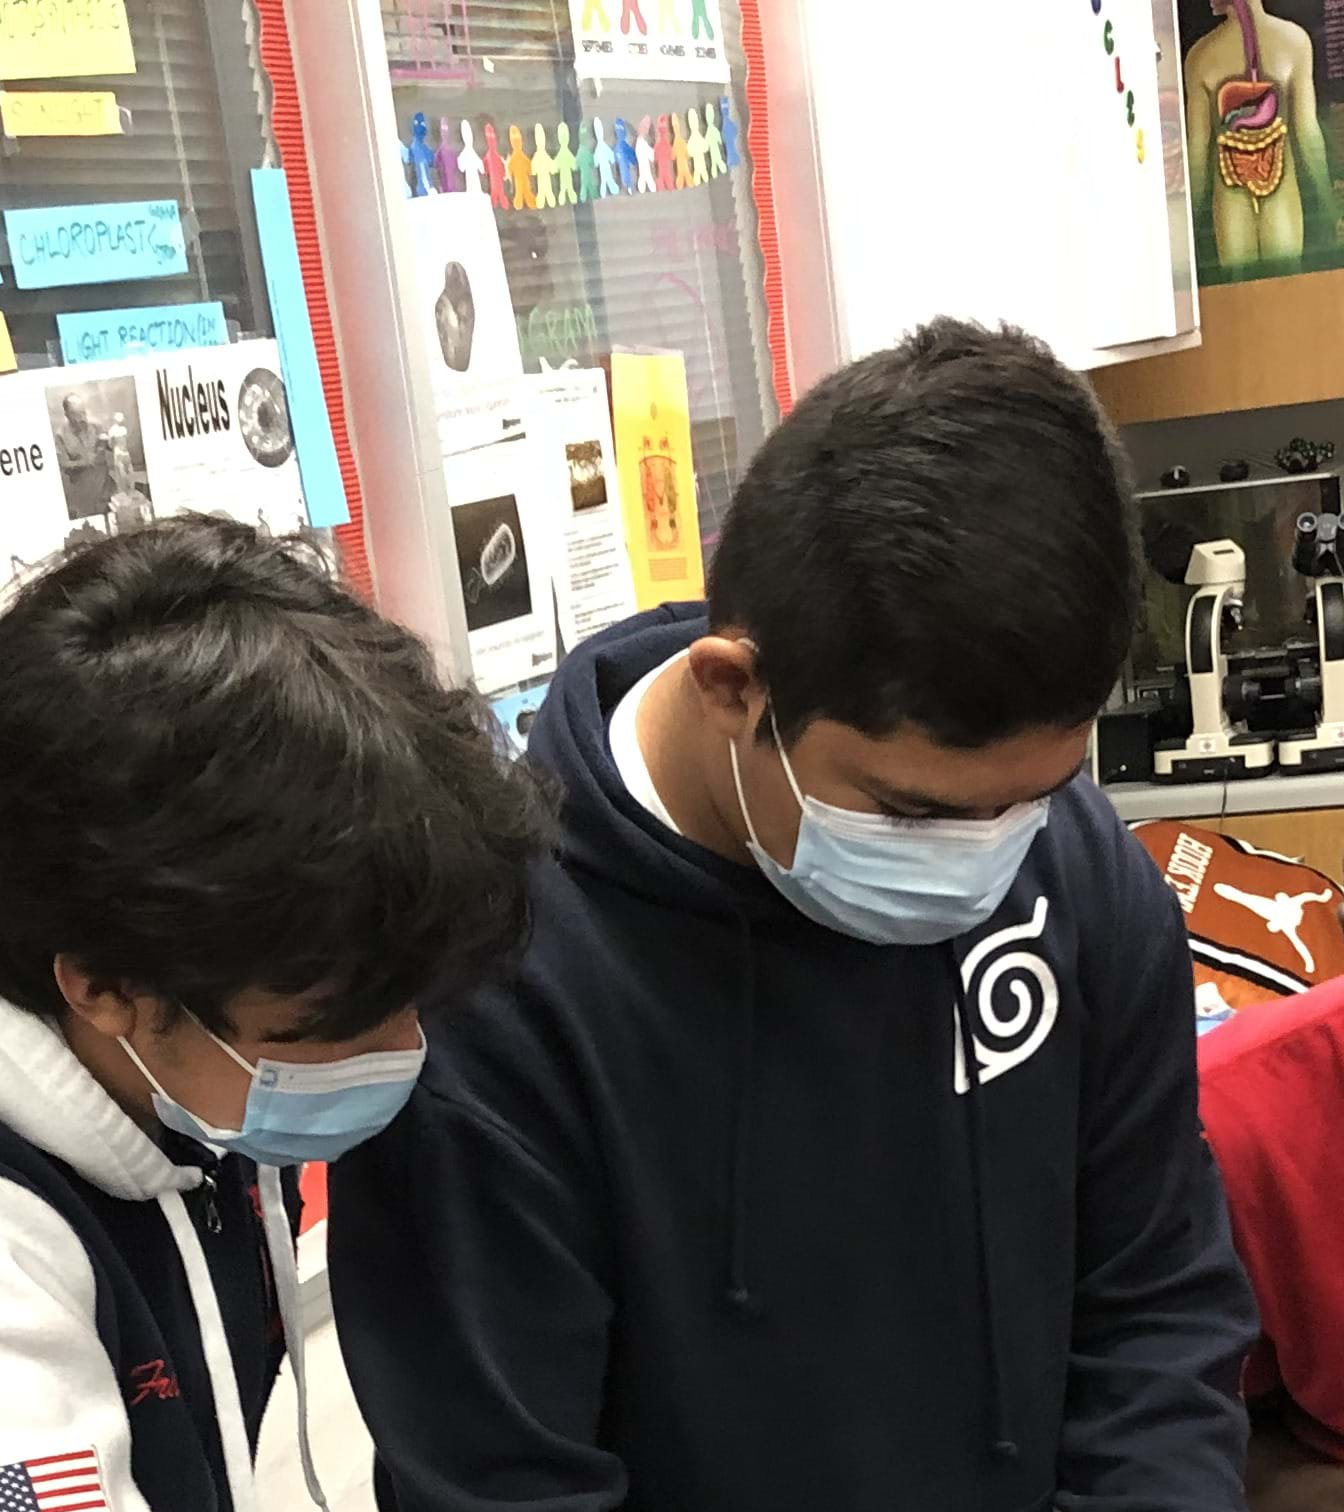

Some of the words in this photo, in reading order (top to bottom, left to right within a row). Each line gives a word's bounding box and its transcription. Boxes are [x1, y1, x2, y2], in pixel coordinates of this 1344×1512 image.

[20, 218, 146, 266] CHLOROPLAST
[64, 329, 109, 364] LIGHT
[118, 318, 196, 348] REACTION
[156, 365, 231, 441] Nucleus
